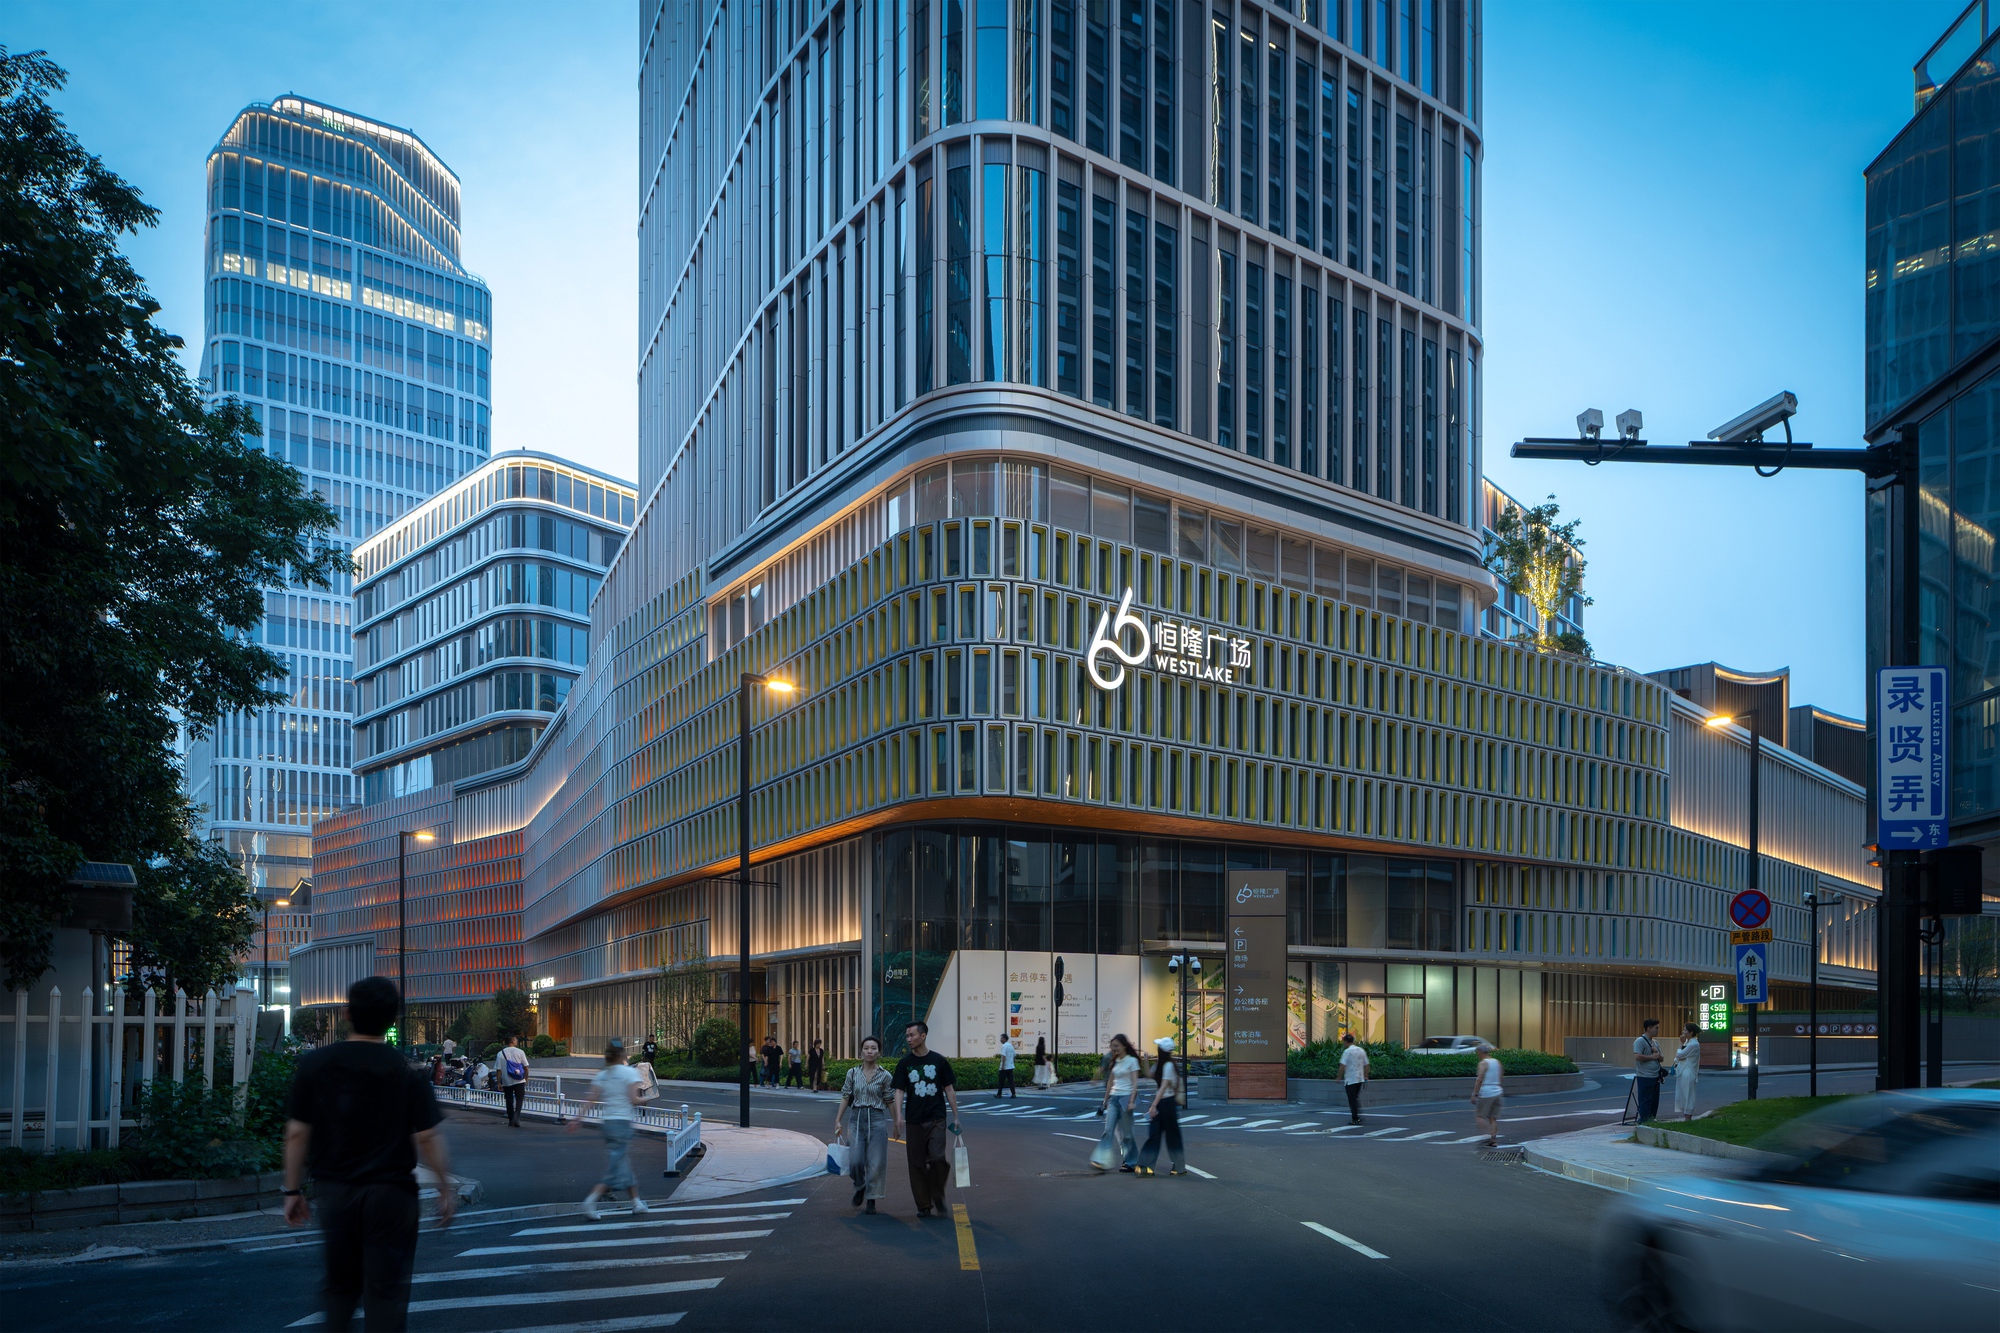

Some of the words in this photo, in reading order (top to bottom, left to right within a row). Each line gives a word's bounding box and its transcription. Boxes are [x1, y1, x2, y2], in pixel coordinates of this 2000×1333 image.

[1154, 620, 1251, 669] 恒隆广场
[1155, 654, 1233, 684] WESTLAKE
[1932, 701, 1943, 746] Luxian
[1887, 676, 1925, 813] 录贤弄
[1931, 753, 1942, 787] Alley
[1929, 823, 1941, 836] 东
[1931, 837, 1939, 846] E
[1732, 930, 1771, 943] 严管路段
[1010, 972, 1073, 984] 会员停车遇
[1745, 955, 1758, 997] 单行路
